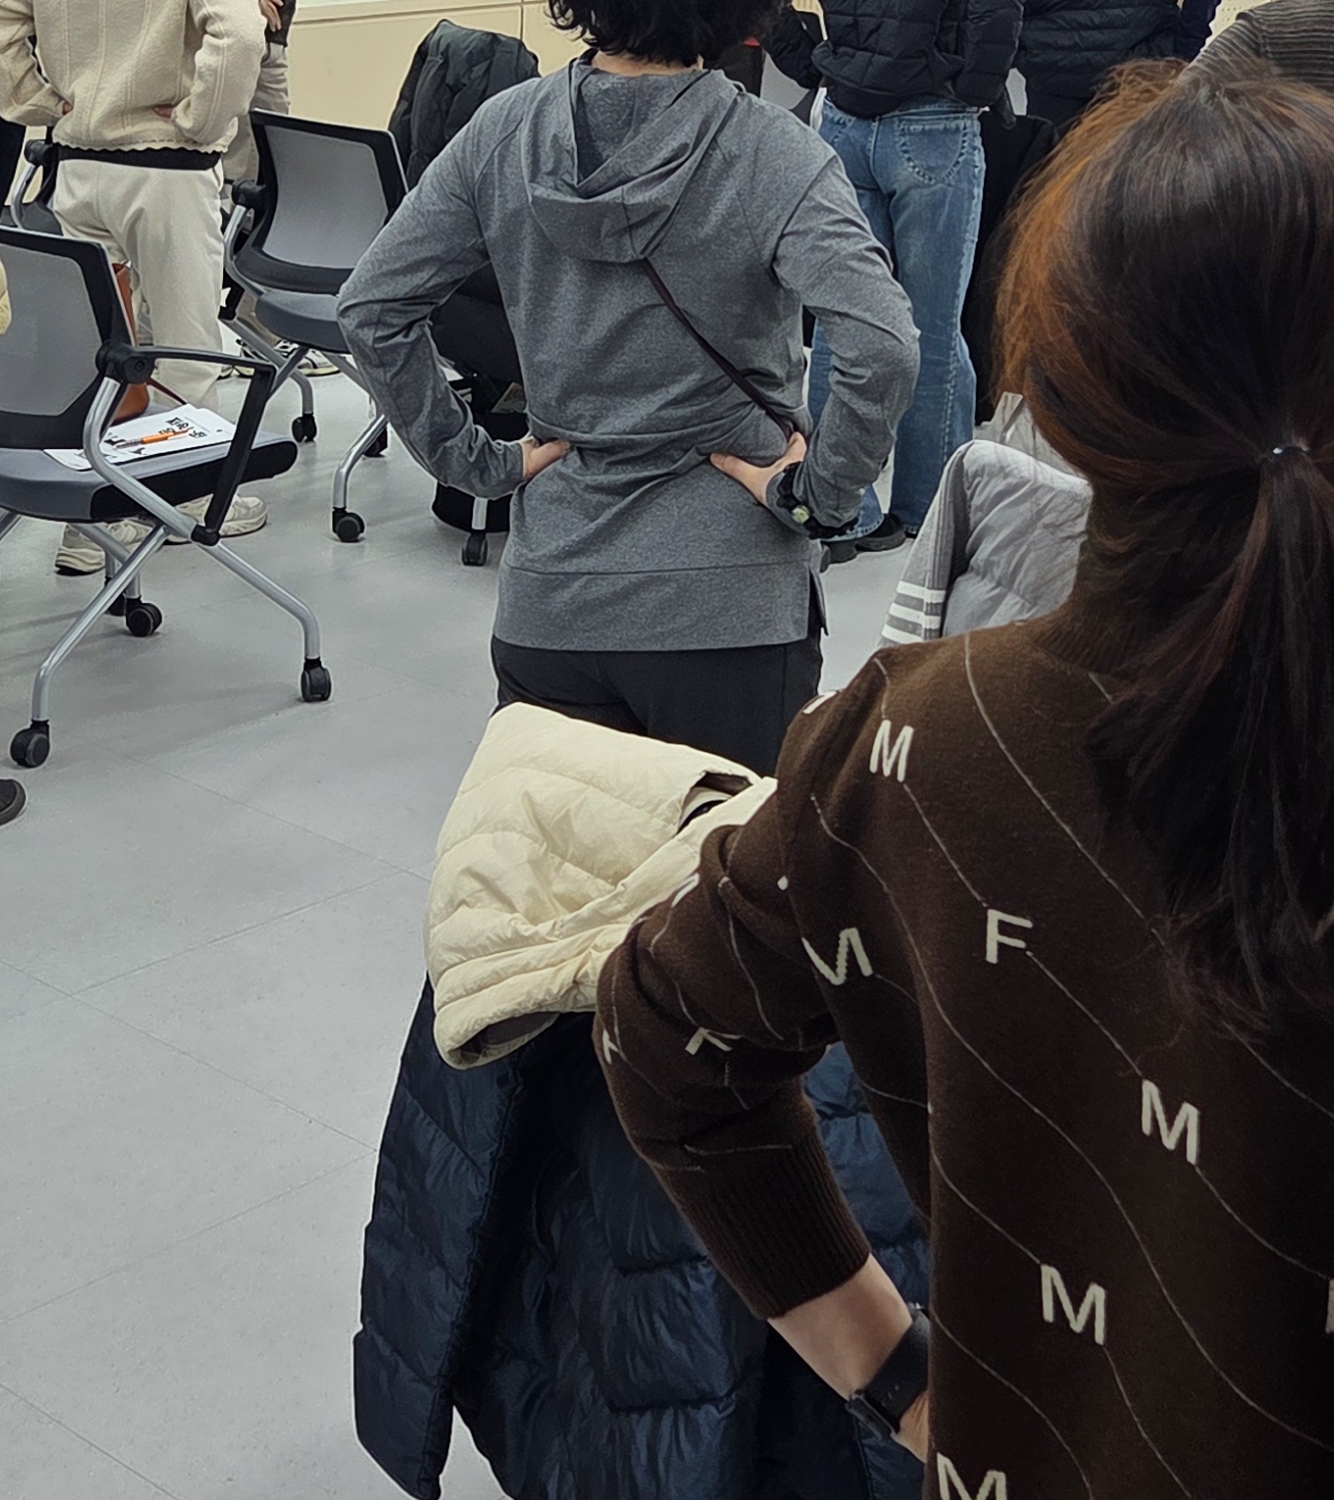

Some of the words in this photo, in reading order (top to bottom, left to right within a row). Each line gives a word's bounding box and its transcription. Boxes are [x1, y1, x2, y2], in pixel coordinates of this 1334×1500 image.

[869, 719, 914, 782] M
[985, 908, 1034, 964] F
[1141, 1078, 1200, 1165] M
[1039, 1263, 1106, 1347] M
